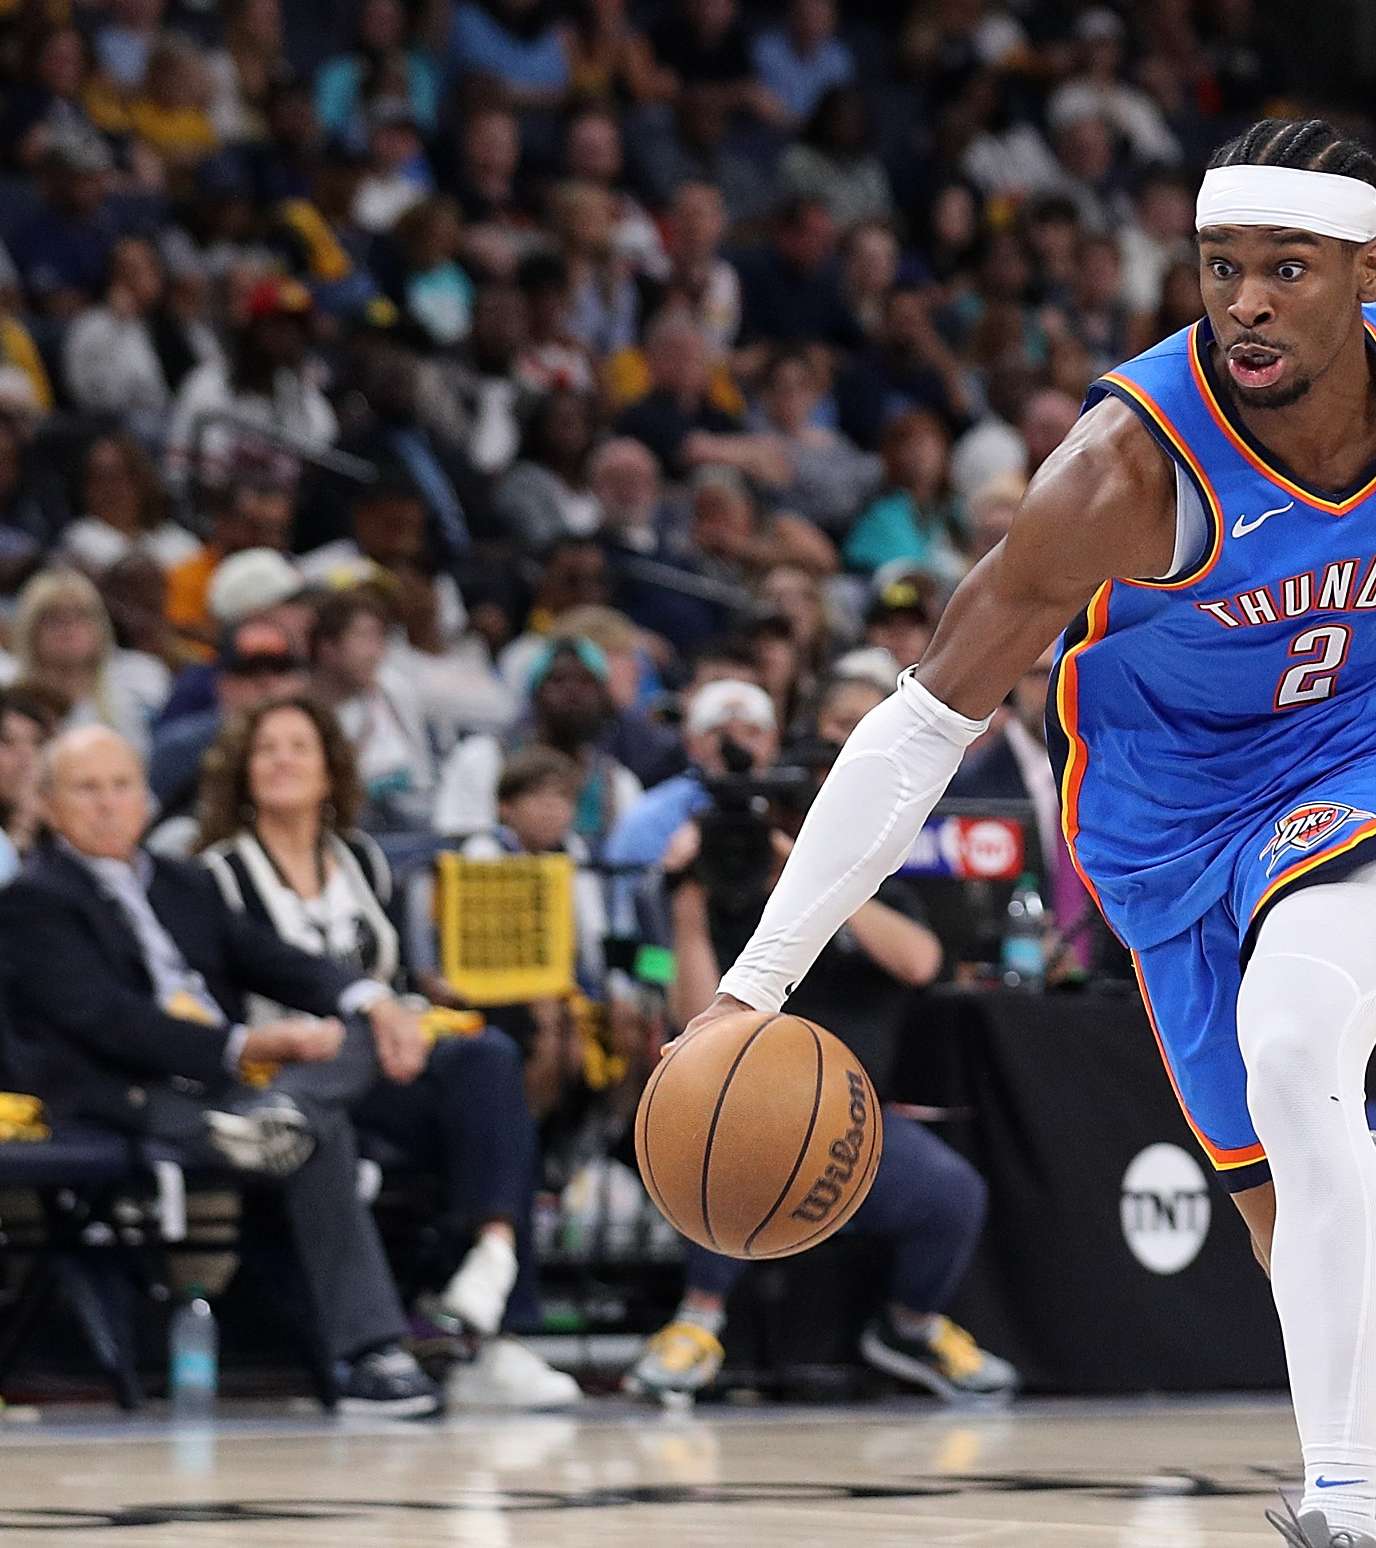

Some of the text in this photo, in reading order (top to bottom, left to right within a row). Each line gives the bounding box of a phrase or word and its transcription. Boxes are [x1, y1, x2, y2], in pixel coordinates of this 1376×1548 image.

[1274, 624, 1352, 712] 2
[1274, 808, 1335, 854] OKC
[789, 1070, 866, 1222] Wilson
[1122, 1188, 1210, 1231] TNT
